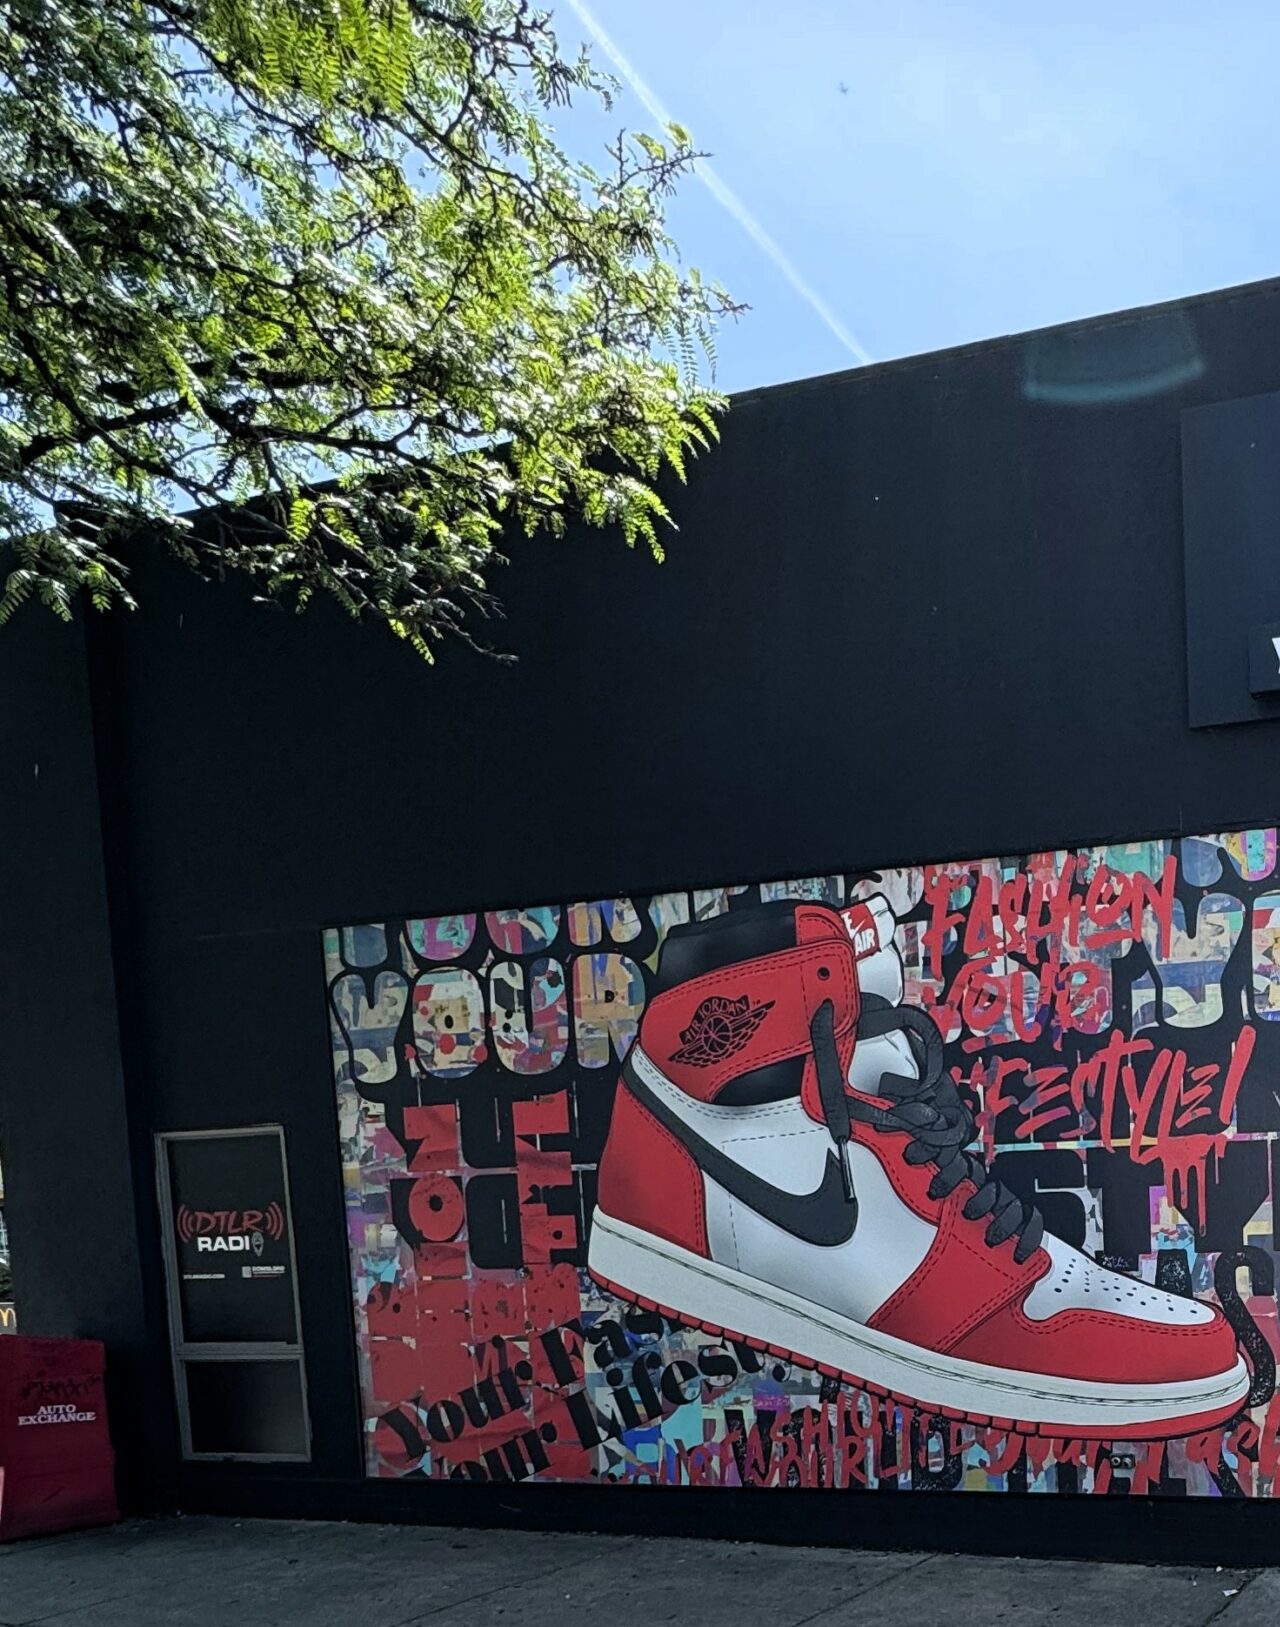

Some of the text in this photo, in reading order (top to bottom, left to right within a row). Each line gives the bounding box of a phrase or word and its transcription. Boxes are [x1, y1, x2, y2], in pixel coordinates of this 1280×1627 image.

[697, 997, 748, 1018] JORDAN
[331, 953, 646, 1085] YOUR
[195, 1209, 264, 1234] DTLR
[18, 1412, 96, 1426] EXCHANGE
[37, 1404, 76, 1415] AUTO
